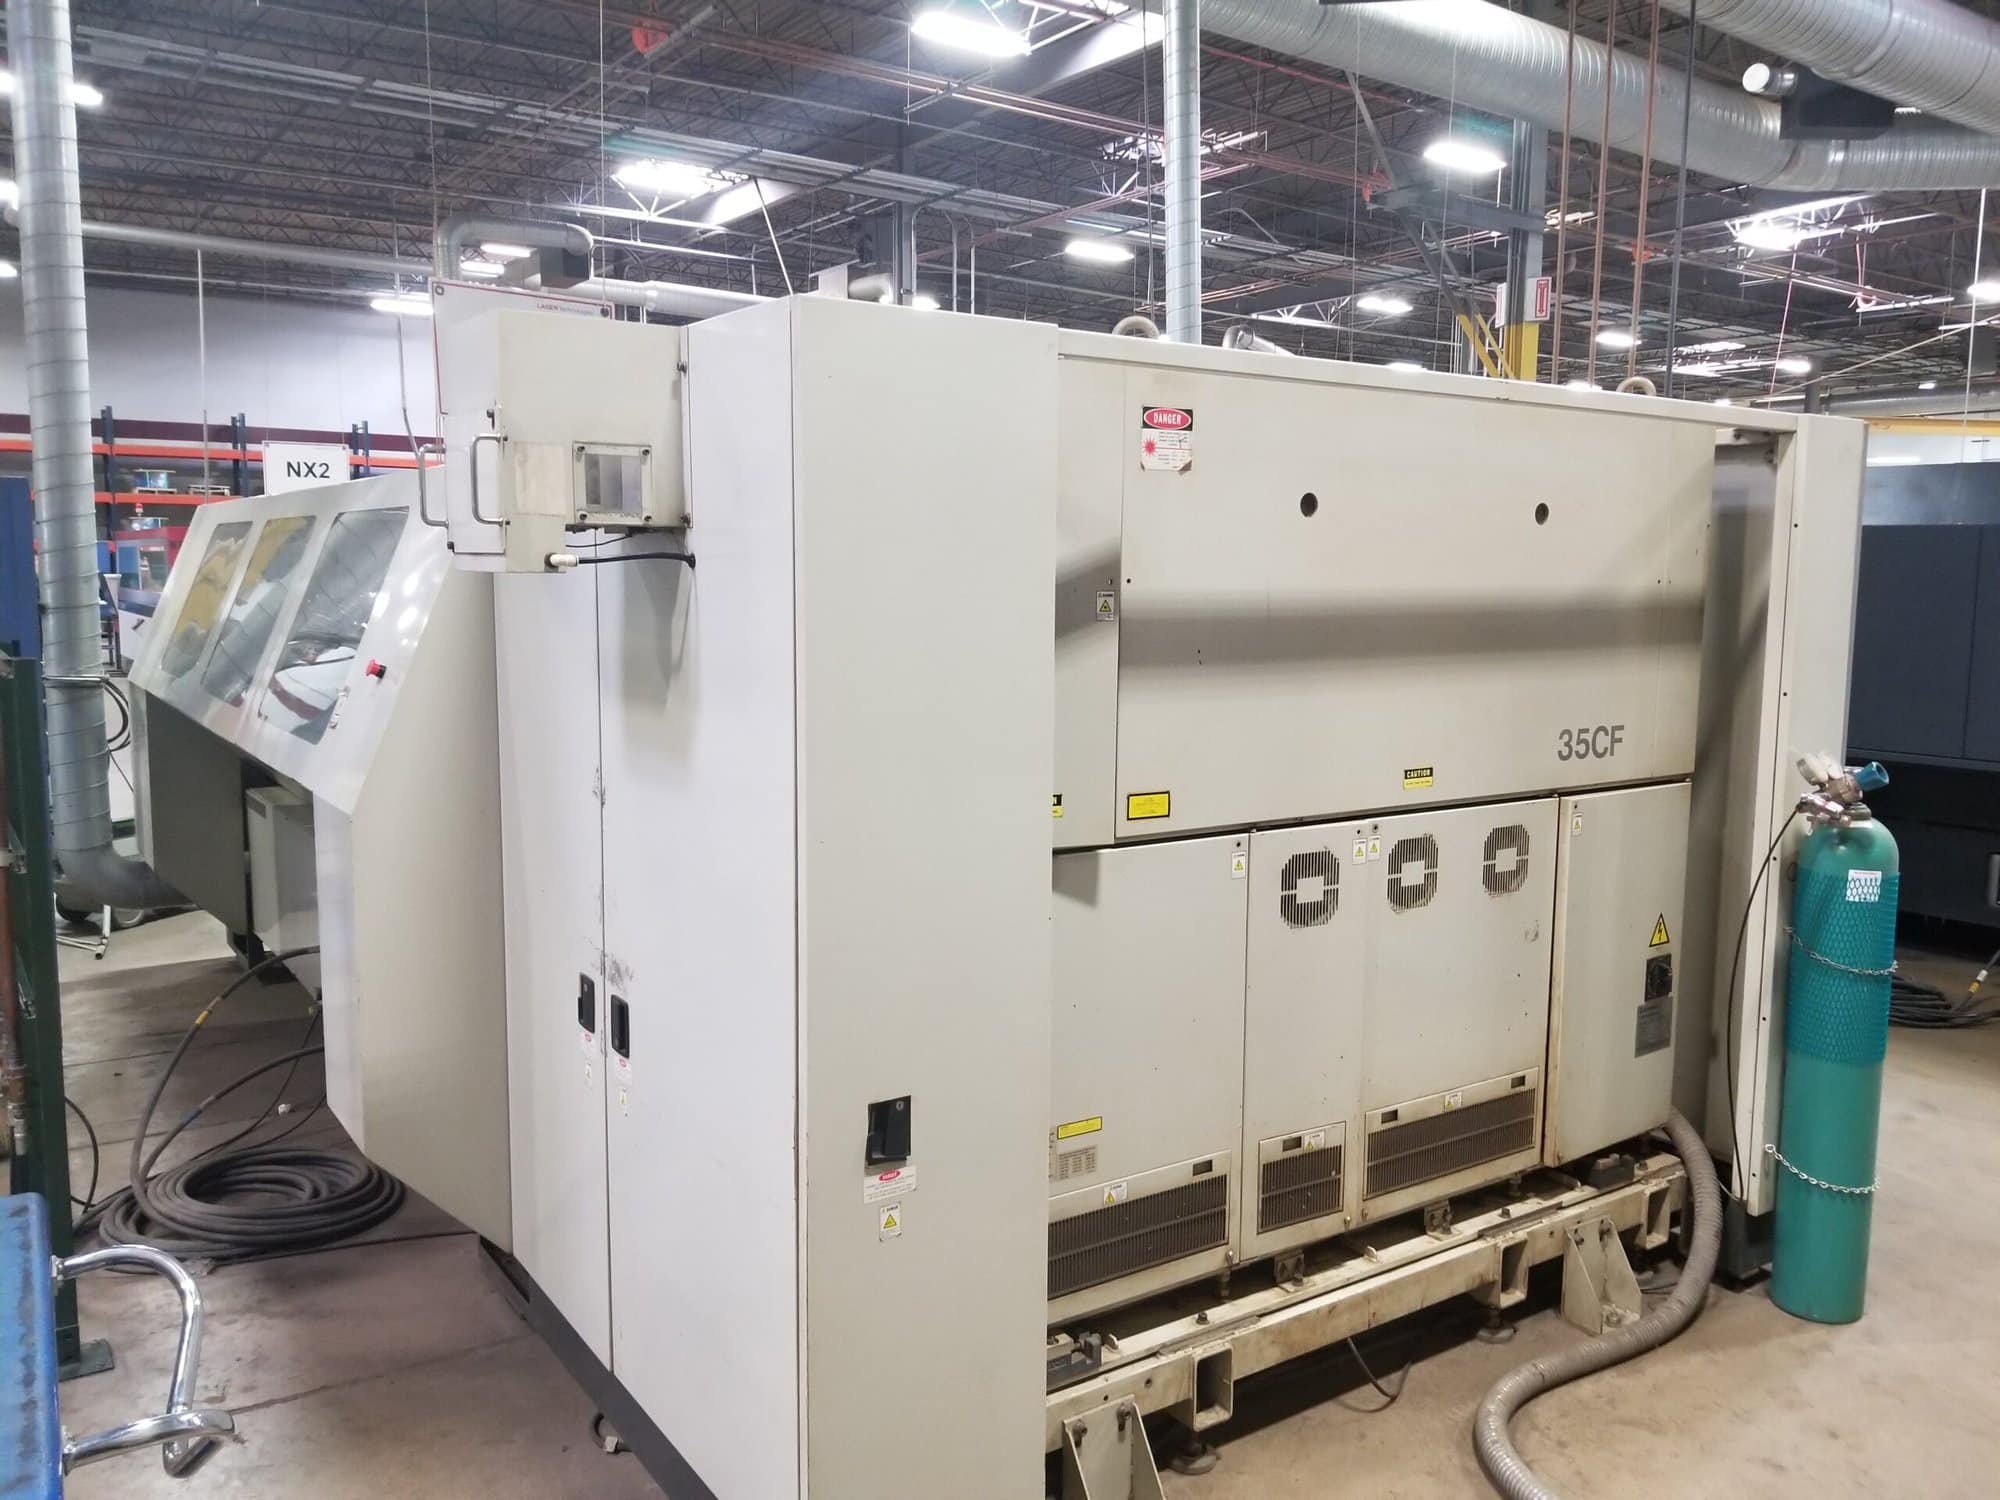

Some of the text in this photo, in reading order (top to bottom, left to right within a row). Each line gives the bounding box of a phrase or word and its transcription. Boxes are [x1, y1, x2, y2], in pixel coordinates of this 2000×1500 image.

[1153, 412, 1182, 425] DANGER
[286, 461, 330, 478] NX2
[1557, 725, 1625, 761] 35CF
[1406, 769, 1431, 778] CAUTION
